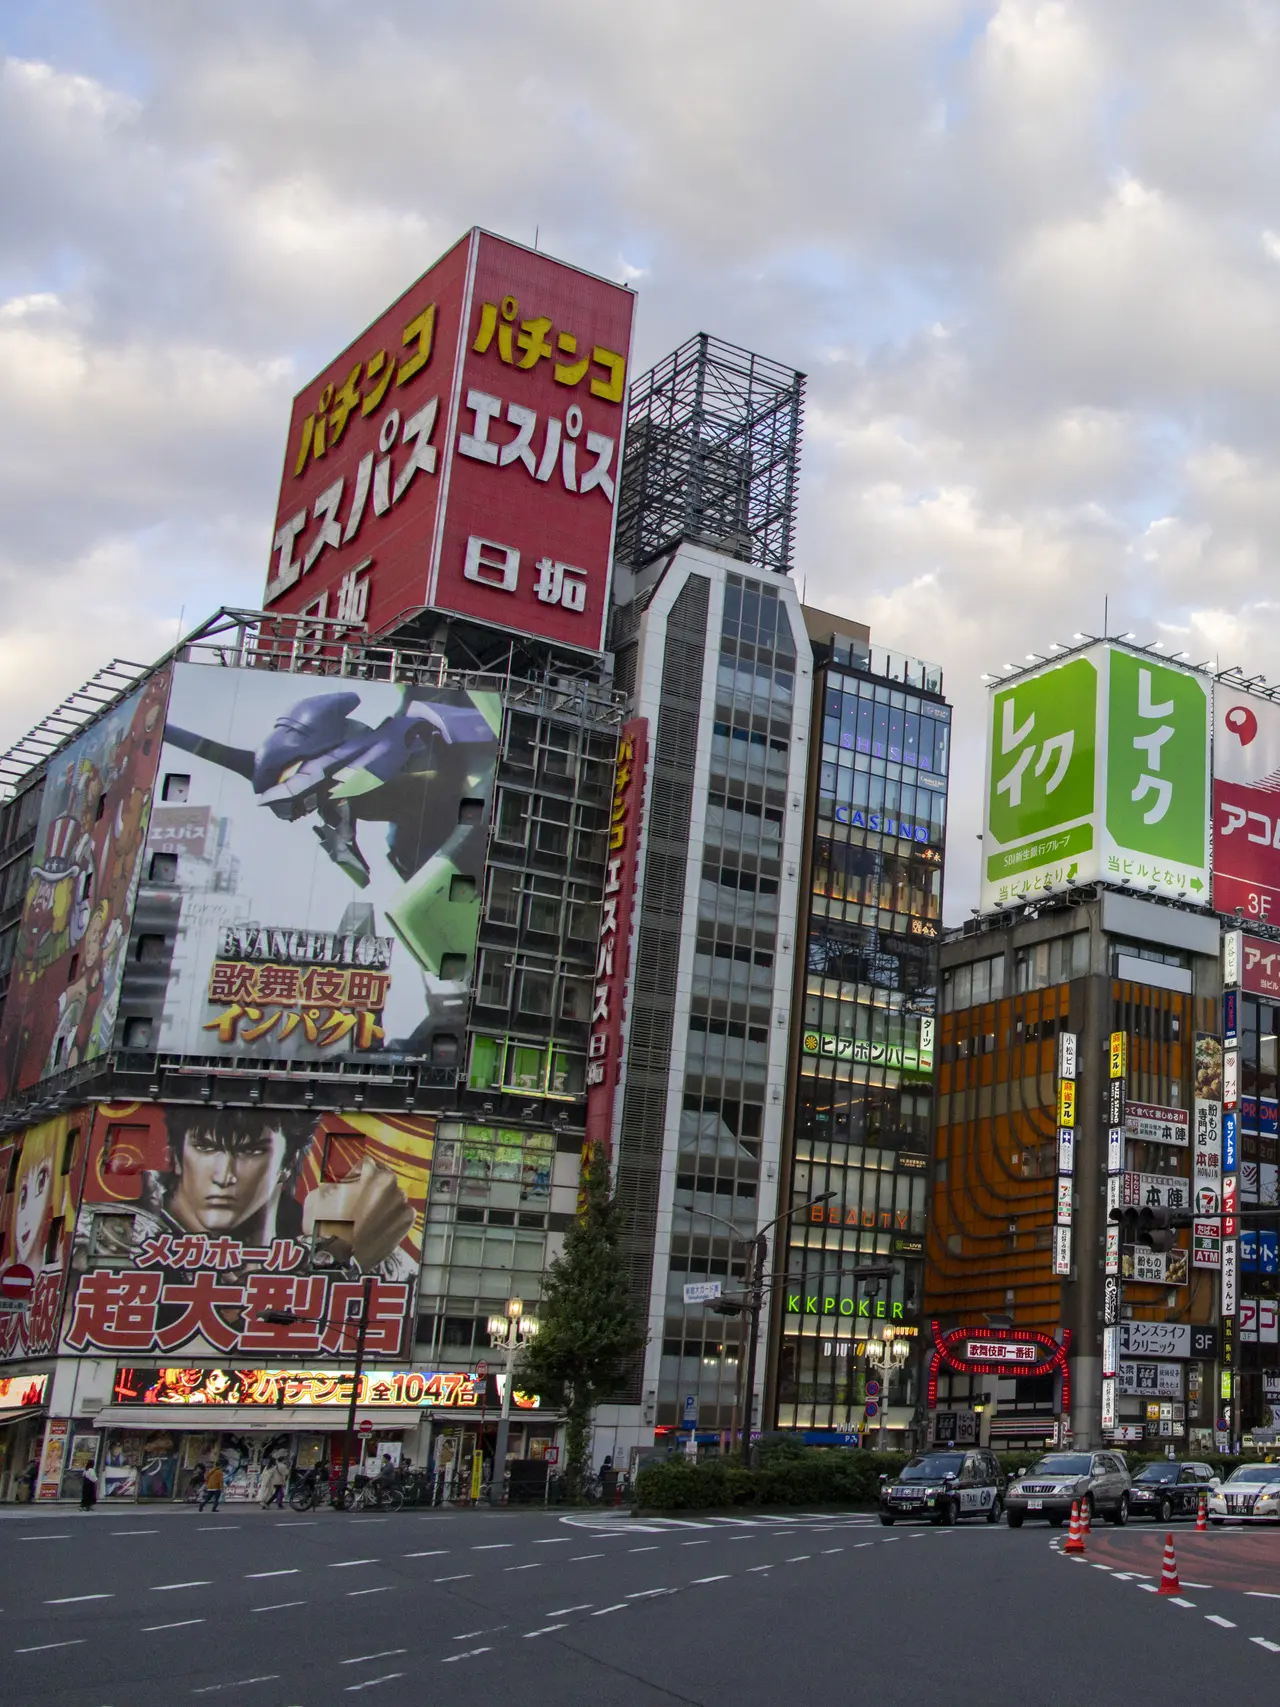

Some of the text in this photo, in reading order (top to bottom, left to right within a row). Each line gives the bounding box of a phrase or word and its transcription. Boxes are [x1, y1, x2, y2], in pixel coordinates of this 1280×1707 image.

[472, 295, 625, 403] パチンコ
[293, 302, 438, 479] パチンコ
[459, 387, 615, 503] エスパス
[264, 396, 439, 605] エスパス
[463, 535, 587, 612] 日拓
[840, 733, 931, 772] SHISHA
[996, 697, 1075, 808] レイク
[1131, 667, 1175, 826] レイク
[609, 733, 634, 850] パチンコ
[836, 806, 929, 843] CASINO
[1003, 834, 1071, 869] SBI新生銀行グループ
[998, 868, 1064, 902] 当ビルとなり
[1107, 855, 1187, 888] 当ビルとなり
[1247, 892, 1272, 918] 3F
[220, 926, 394, 967] EVANGELION
[591, 858, 622, 1026] エスパス
[211, 963, 391, 1006] 歌舞伎町
[1260, 978, 1279, 991] 当ビル
[203, 1003, 386, 1049] インパクト
[923, 1018, 931, 1047] ダーツ
[821, 1037, 916, 1065] ビアポンバー
[1065, 1036, 1074, 1076] 小松ビル
[1112, 1033, 1120, 1070] 麻雀ブル
[1063, 1081, 1073, 1118] 麻雀ブル
[1161, 1125, 1186, 1142] 本陣
[1197, 1108, 1208, 1146] 専門店
[1207, 1103, 1218, 1142] 粉もの
[1196, 1151, 1219, 1168] 本陣
[1226, 1120, 1234, 1165] セントラル
[1197, 1168, 1218, 1178] HONJIN
[1146, 1185, 1183, 1209] 本陣
[1197, 1225, 1217, 1235] たばこ
[1201, 1238, 1212, 1249] 酒
[136, 1234, 304, 1270] メガホール
[1137, 1255, 1162, 1268] 粉もの
[1196, 1252, 1219, 1263] ATM
[1137, 1267, 1162, 1279] 専門店
[66, 1271, 411, 1355] 超大型店
[1131, 1323, 1186, 1339] メンズライフ
[969, 1344, 1034, 1360] 歌舞伎町一番街
[1131, 1340, 1176, 1354] クリニック
[1195, 1334, 1213, 1350] 3F
[370, 1373, 478, 1404] 全1047台
